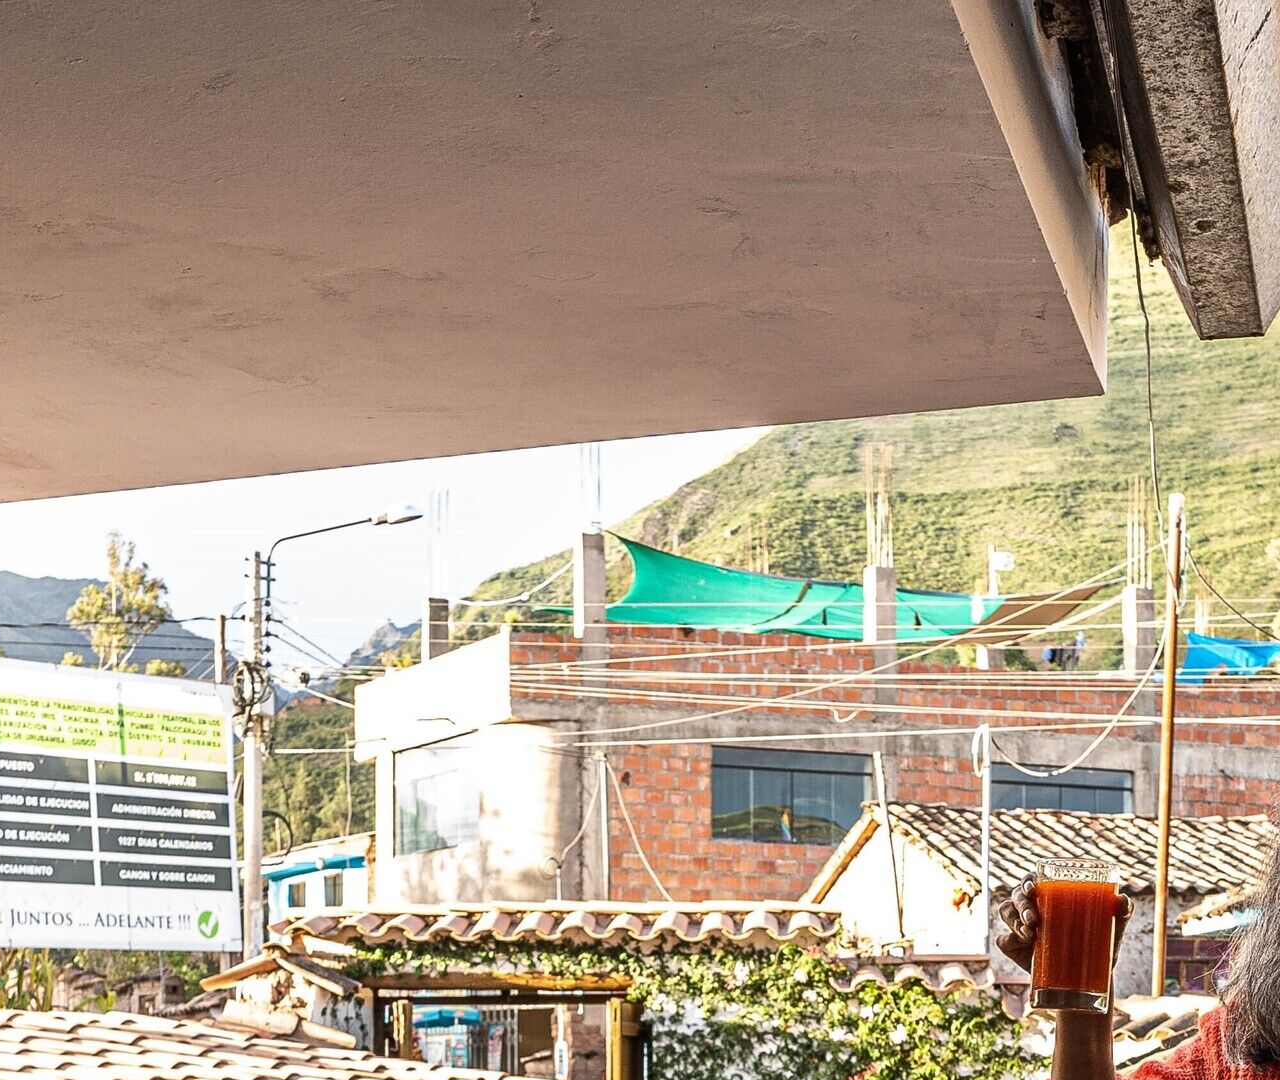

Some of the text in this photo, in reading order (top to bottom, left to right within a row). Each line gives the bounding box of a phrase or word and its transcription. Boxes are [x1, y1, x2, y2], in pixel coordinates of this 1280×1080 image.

[107, 719, 125, 728] PUA
[25, 795, 38, 807] DE
[111, 803, 216, 820] ADMINISTRACIÓN DIRECTA
[4, 829, 17, 840] DE
[19, 830, 70, 843] EJECUCIÓN
[158, 838, 214, 851] CALENDARIOS
[119, 869, 215, 884] CANON Y SOBRE CANON
[9, 908, 73, 927] JUNTOS
[94, 912, 173, 929] ADELANTE
